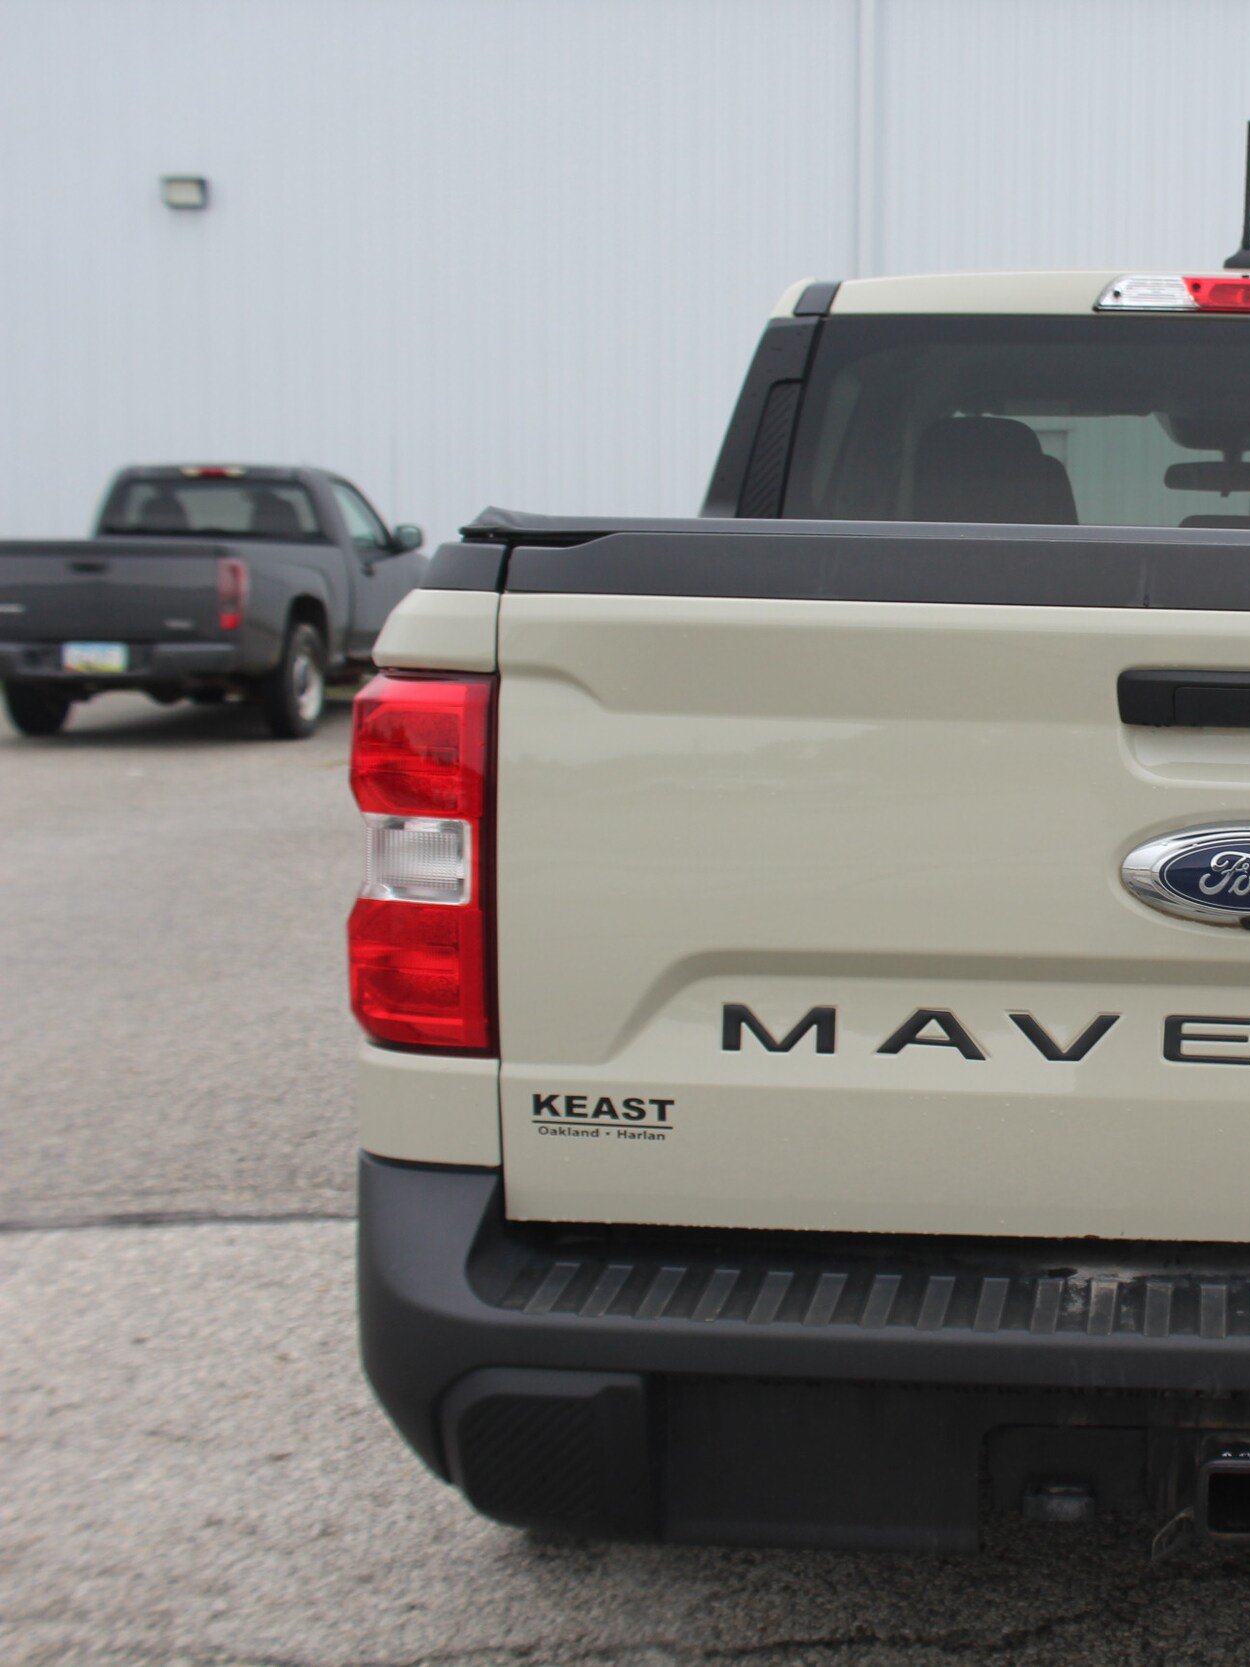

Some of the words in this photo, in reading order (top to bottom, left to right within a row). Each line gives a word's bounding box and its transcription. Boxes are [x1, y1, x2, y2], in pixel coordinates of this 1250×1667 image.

[532, 1093, 676, 1122] KEAST
[537, 1126, 600, 1138] Oakland
[617, 1129, 666, 1141] Harlan
